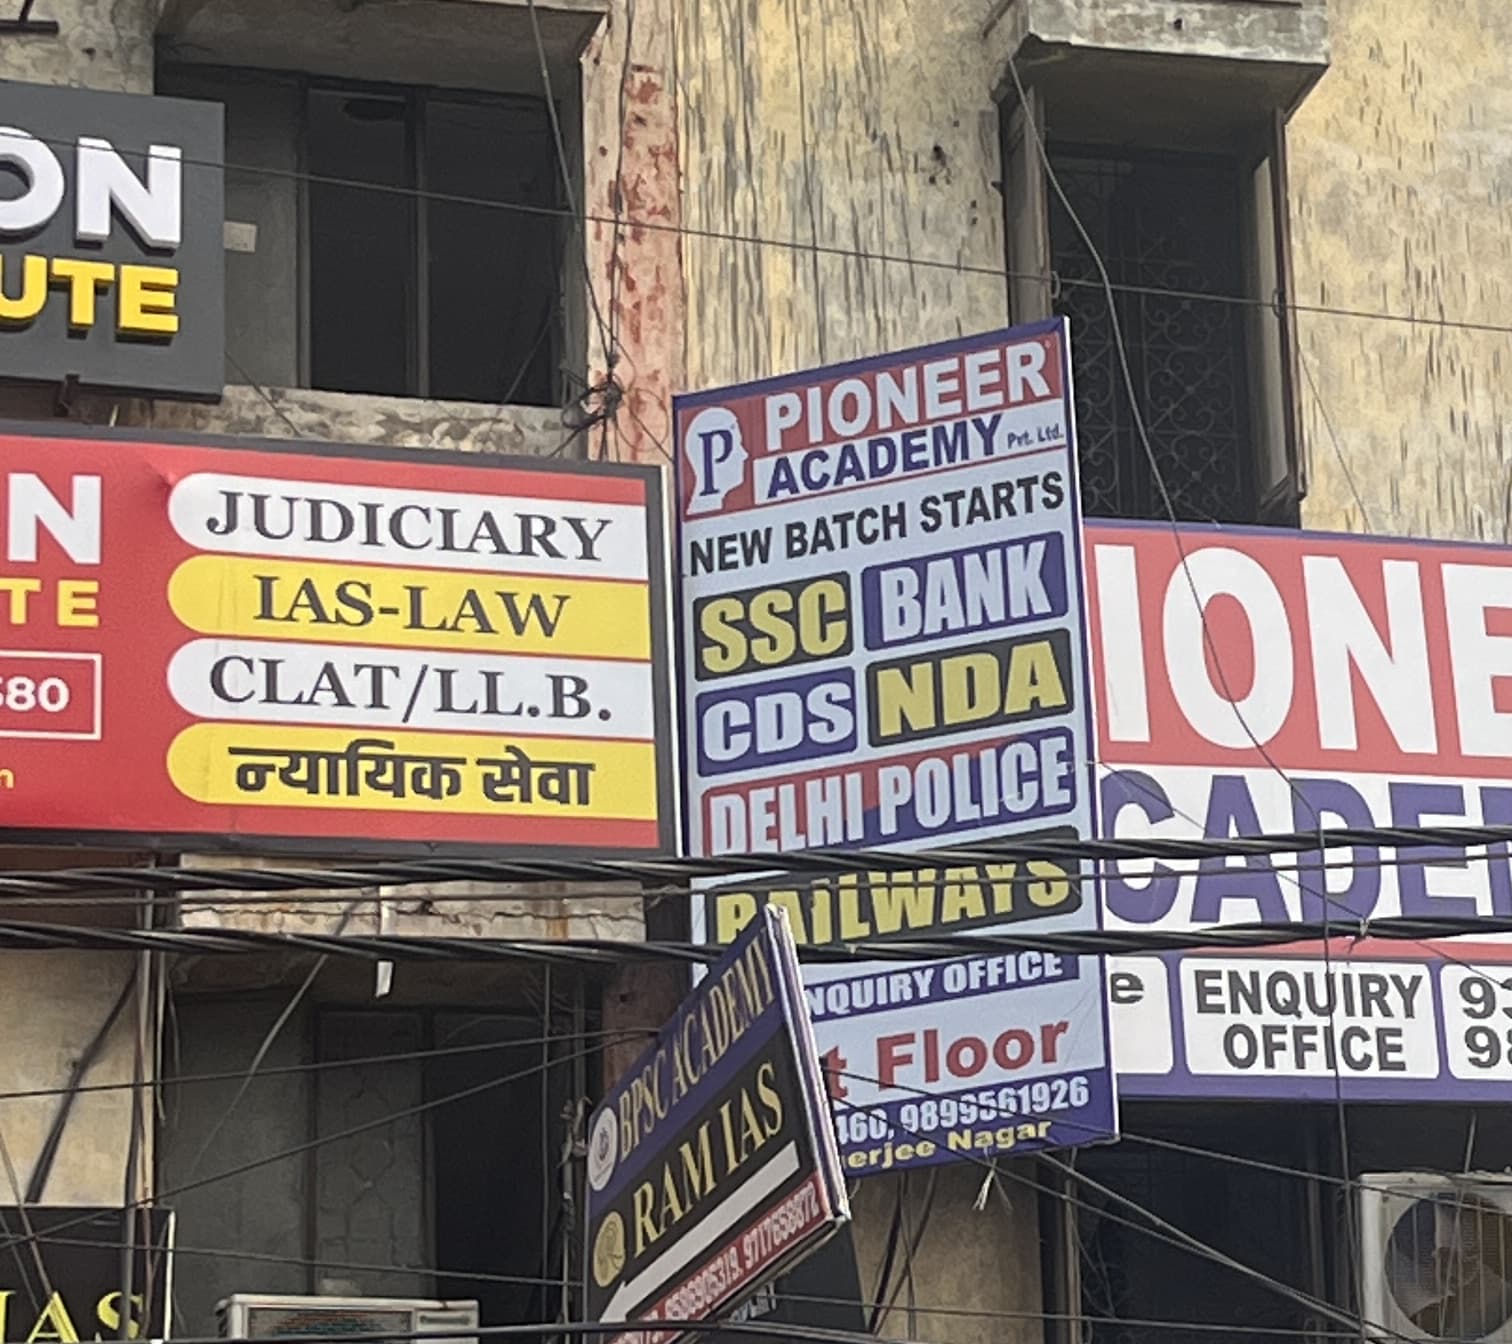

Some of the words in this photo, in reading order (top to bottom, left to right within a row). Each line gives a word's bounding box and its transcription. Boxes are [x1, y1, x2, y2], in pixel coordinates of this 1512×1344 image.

[765, 341, 1050, 452] PIONEER
[767, 413, 1003, 499] ACADEMY
[1007, 429, 1035, 450] Pvt.
[1037, 422, 1064, 443] Ltd.
[206, 489, 613, 562] JUDICIARY
[690, 527, 773, 576] NEW
[786, 501, 907, 559] BATCH
[919, 471, 1065, 533] STARTS
[253, 574, 571, 638] IAS-LAW
[701, 579, 848, 674] SSC
[879, 540, 1052, 644] BANK
[209, 655, 612, 724] CLAT/LL.B.
[702, 682, 856, 762] CDS
[876, 639, 1067, 738] NDA
[228, 739, 467, 800] न्यायिक
[476, 744, 595, 806] सेवा
[709, 771, 865, 855] DELHI
[879, 736, 1072, 846] POLICE
[943, 951, 1063, 993] OFFICE
[1196, 969, 1423, 1020] ENQUIRY
[618, 1048, 668, 1159] BPSC
[670, 934, 776, 1097] ACADEMY
[877, 1020, 1070, 1091] Floor
[1222, 1023, 1407, 1072] OFFICE
[902, 1076, 1089, 1133] 9899561926
[948, 1118, 1052, 1152] Nagar
[633, 1135, 717, 1257] RAM
[720, 1061, 783, 1176] IAS
